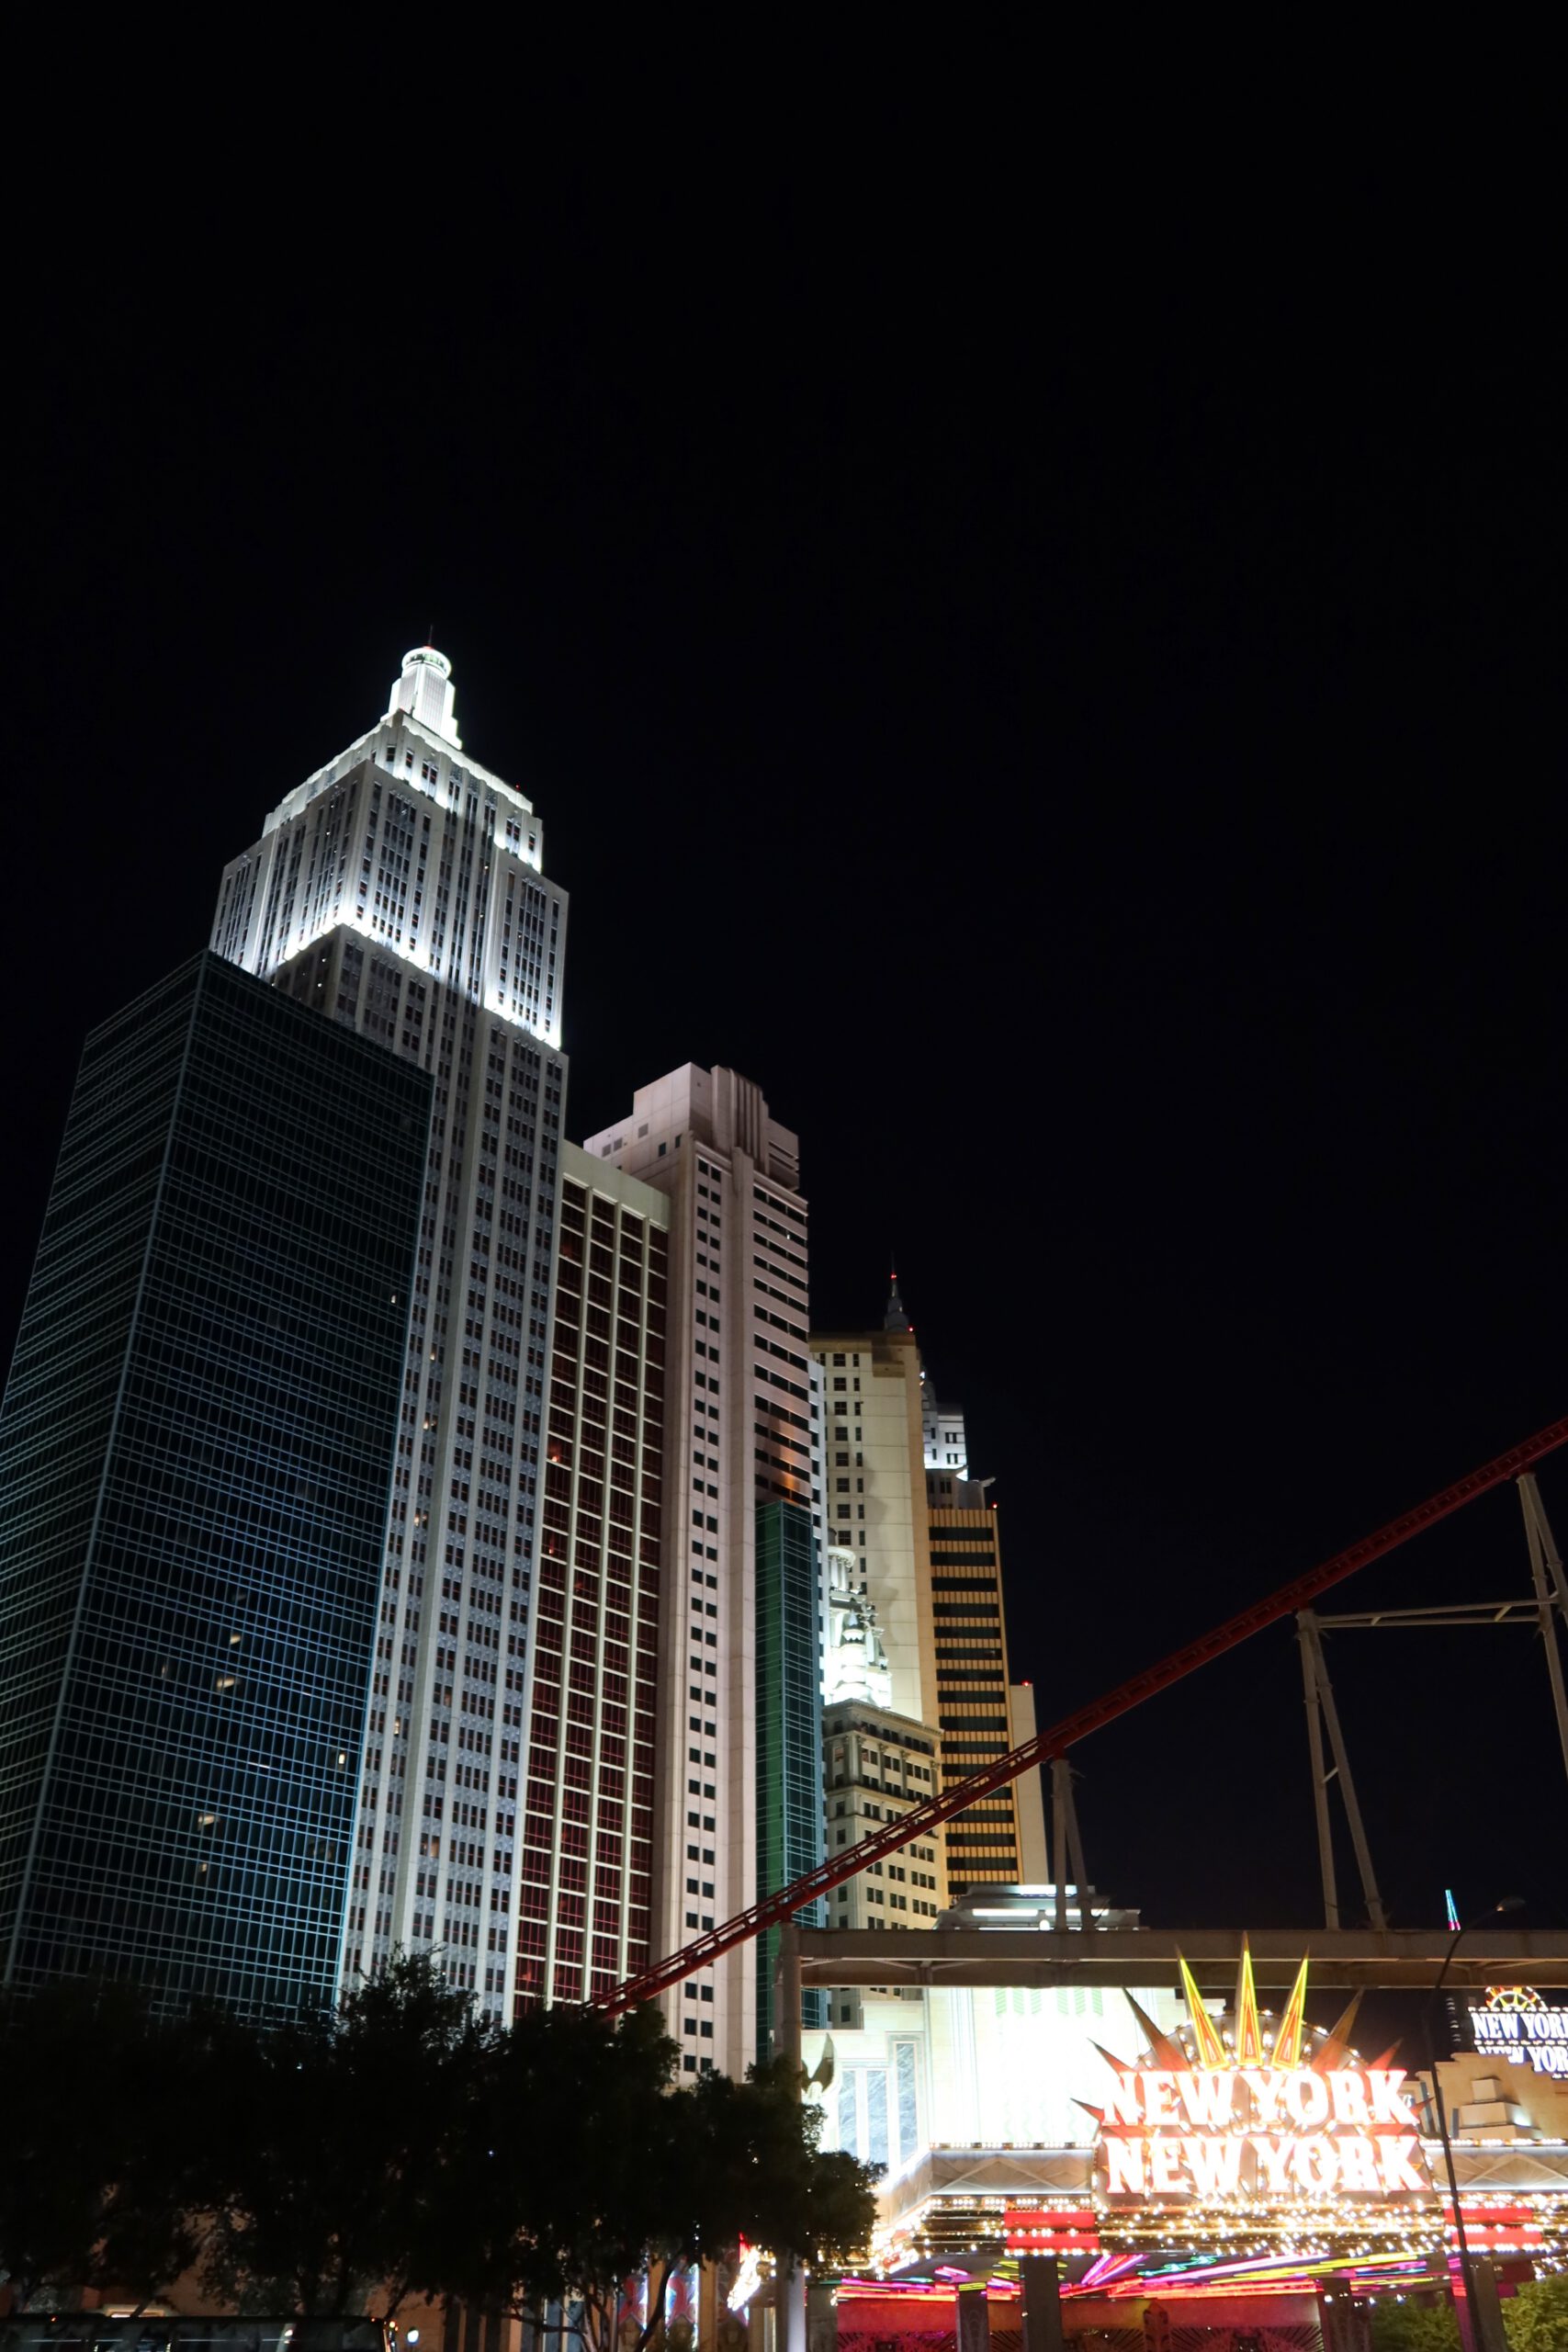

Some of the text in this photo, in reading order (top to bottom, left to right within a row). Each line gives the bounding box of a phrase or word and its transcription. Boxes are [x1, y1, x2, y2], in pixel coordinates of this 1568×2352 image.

[1472, 2013, 1519, 2039] NEW
[1527, 2046, 1568, 2073] YOR
[1102, 2069, 1420, 2125] NEW YORK
[1105, 2134, 1431, 2193] NEW YORK
